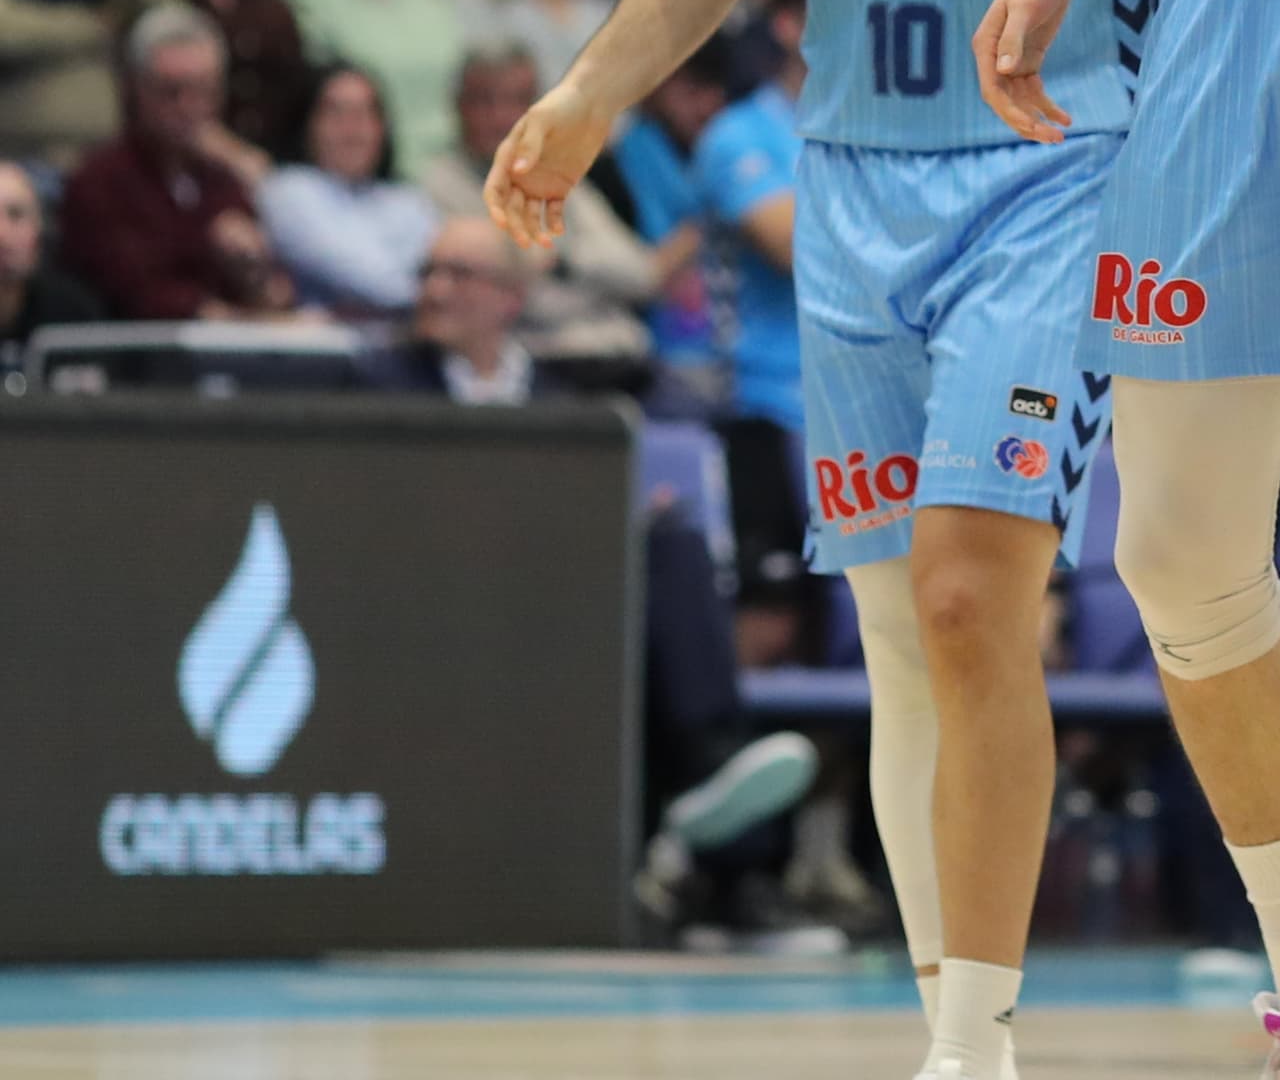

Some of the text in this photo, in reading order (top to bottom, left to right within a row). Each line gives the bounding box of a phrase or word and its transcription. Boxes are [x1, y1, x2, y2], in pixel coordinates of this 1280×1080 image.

[867, 1, 945, 97] 10
[1091, 251, 1208, 328] Río
[1112, 327, 1184, 344] DE GALICIA
[814, 451, 920, 521] Río
